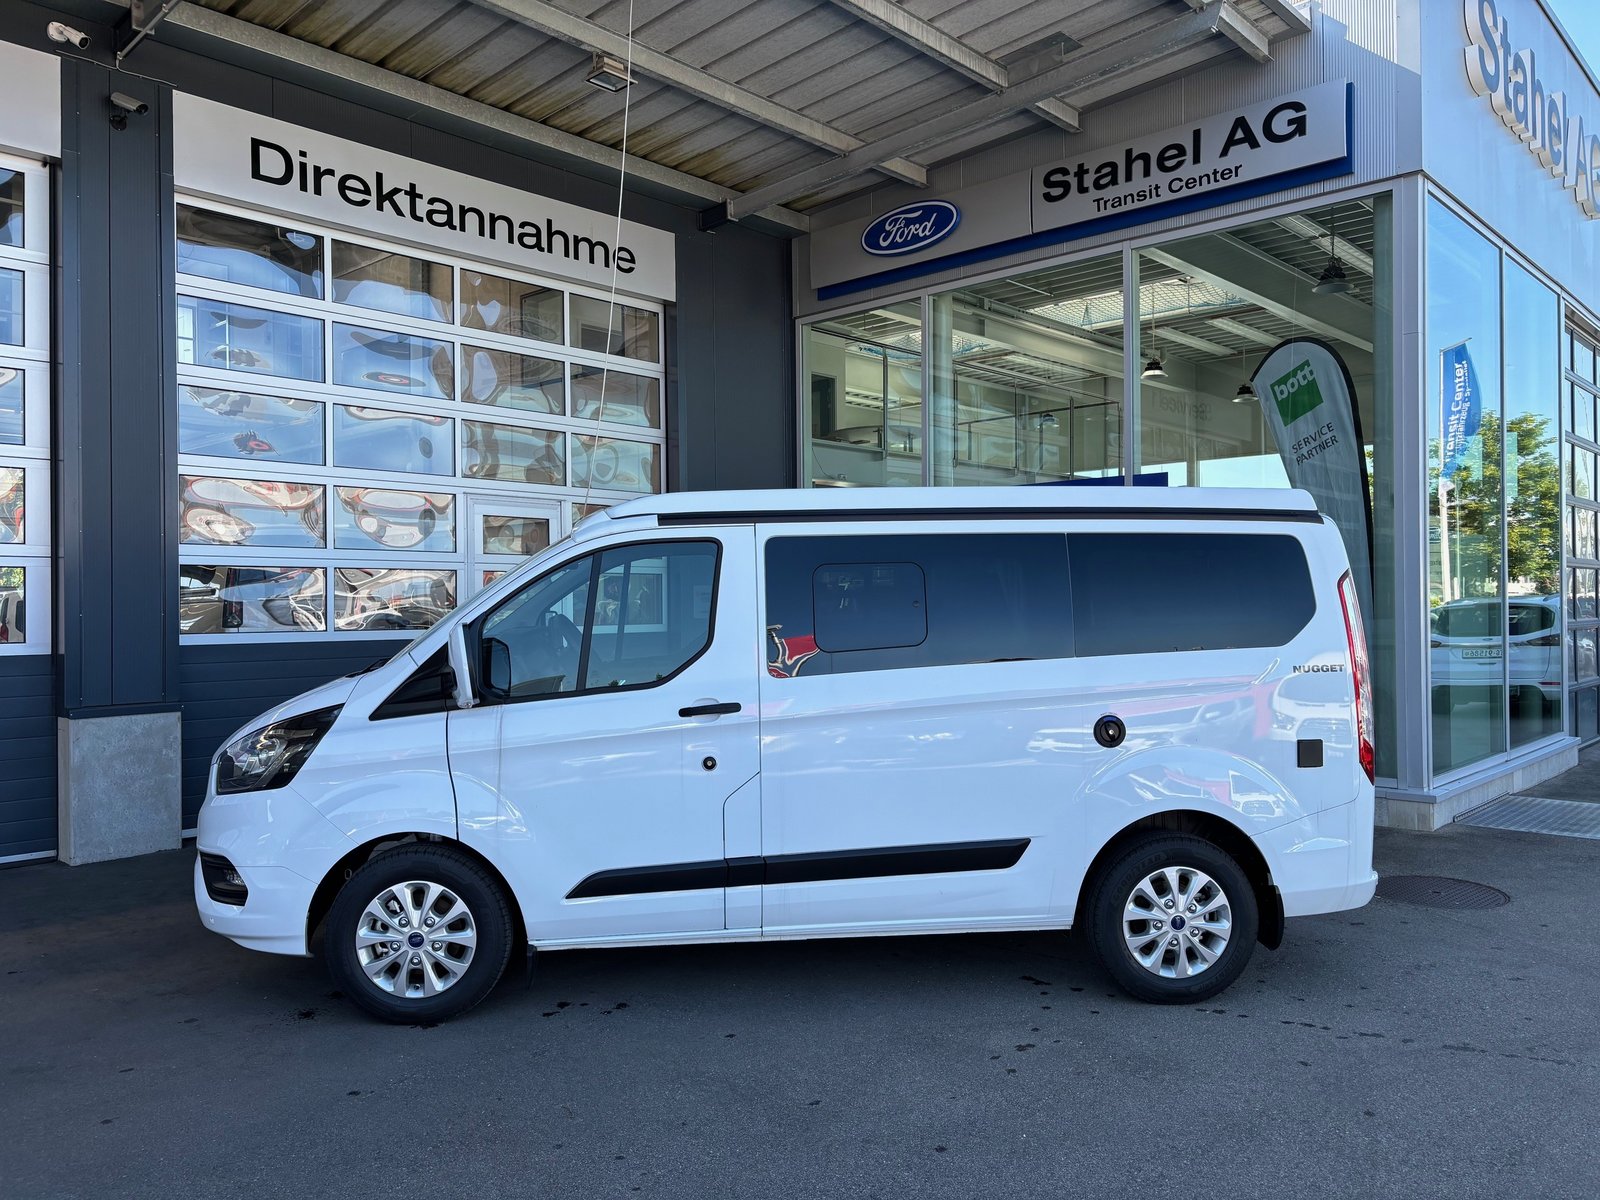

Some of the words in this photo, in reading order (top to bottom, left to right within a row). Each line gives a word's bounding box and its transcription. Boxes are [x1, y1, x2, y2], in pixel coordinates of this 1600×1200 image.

[1464, 0, 1568, 178] Stahel
[1042, 128, 1202, 203] Stahel
[1218, 101, 1307, 158] AG
[250, 136, 637, 274] Direktannahme
[1092, 184, 1161, 213] Transit
[1168, 164, 1243, 194] Center
[879, 209, 938, 247] Ford
[1274, 365, 1316, 401] bott
[1451, 363, 1464, 411] Center
[1292, 422, 1334, 454] SERVICE
[1296, 435, 1339, 466] PARTNER
[1292, 664, 1344, 673] NUGGET
